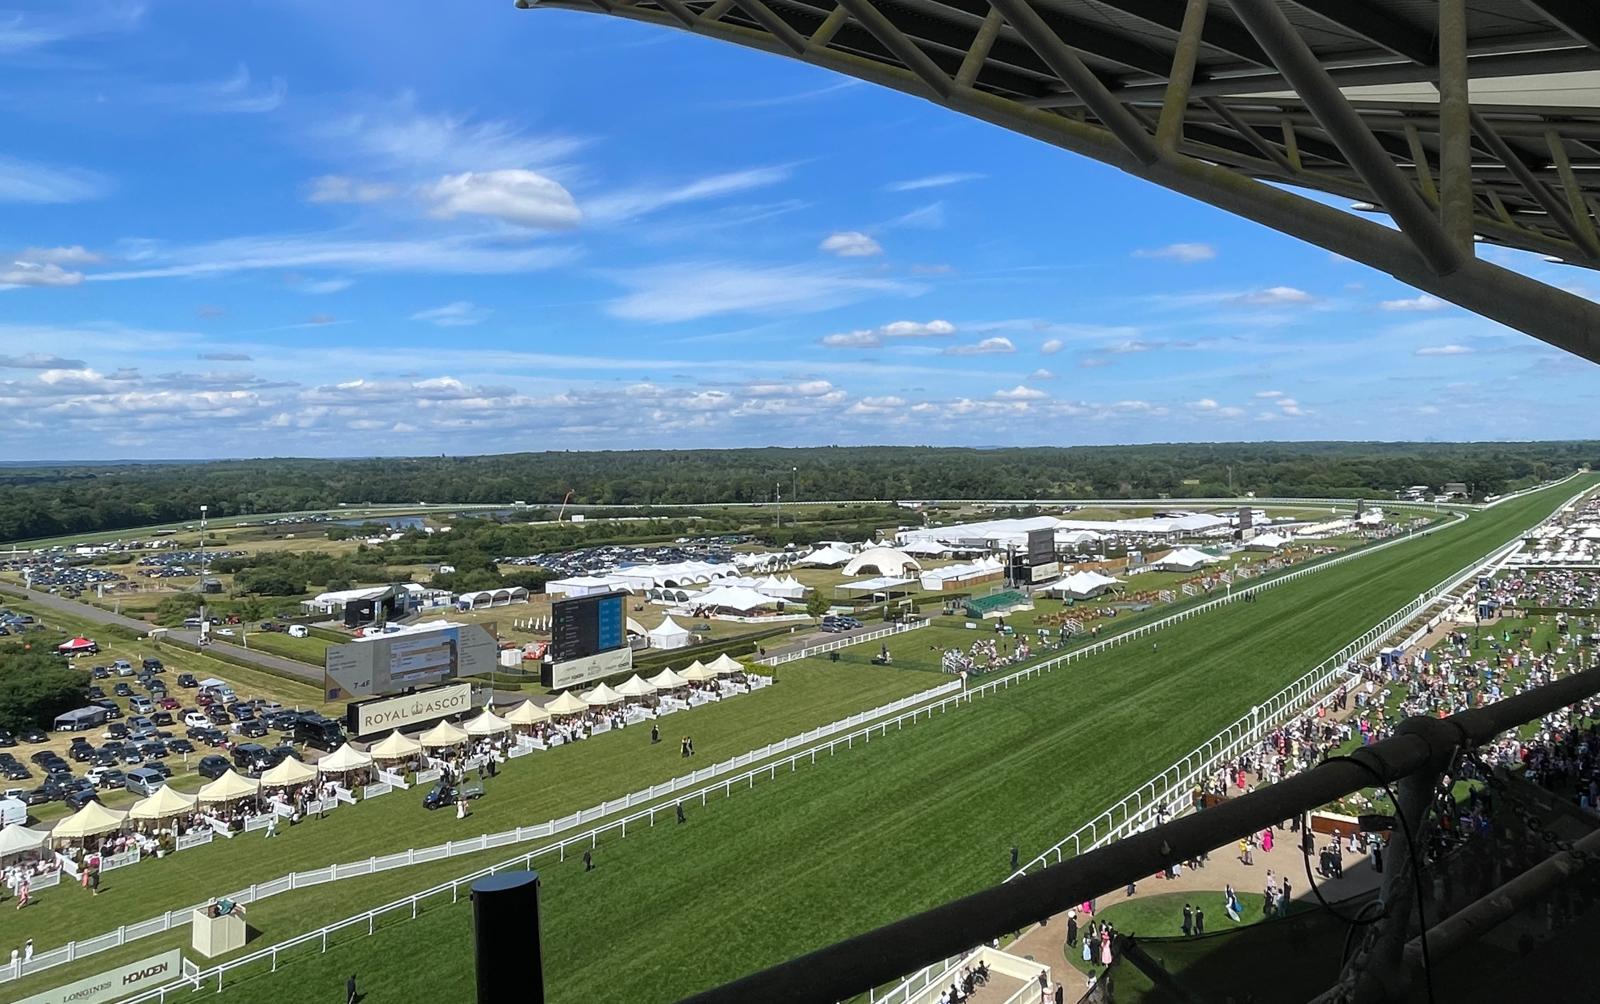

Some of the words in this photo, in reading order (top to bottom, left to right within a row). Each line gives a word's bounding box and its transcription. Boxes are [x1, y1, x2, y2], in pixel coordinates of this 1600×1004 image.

[365, 709, 408, 727] ROYAL
[426, 695, 466, 713] ASCOT
[63, 981, 112, 1002] LONGINES
[123, 962, 168, 985] HOWDEN
